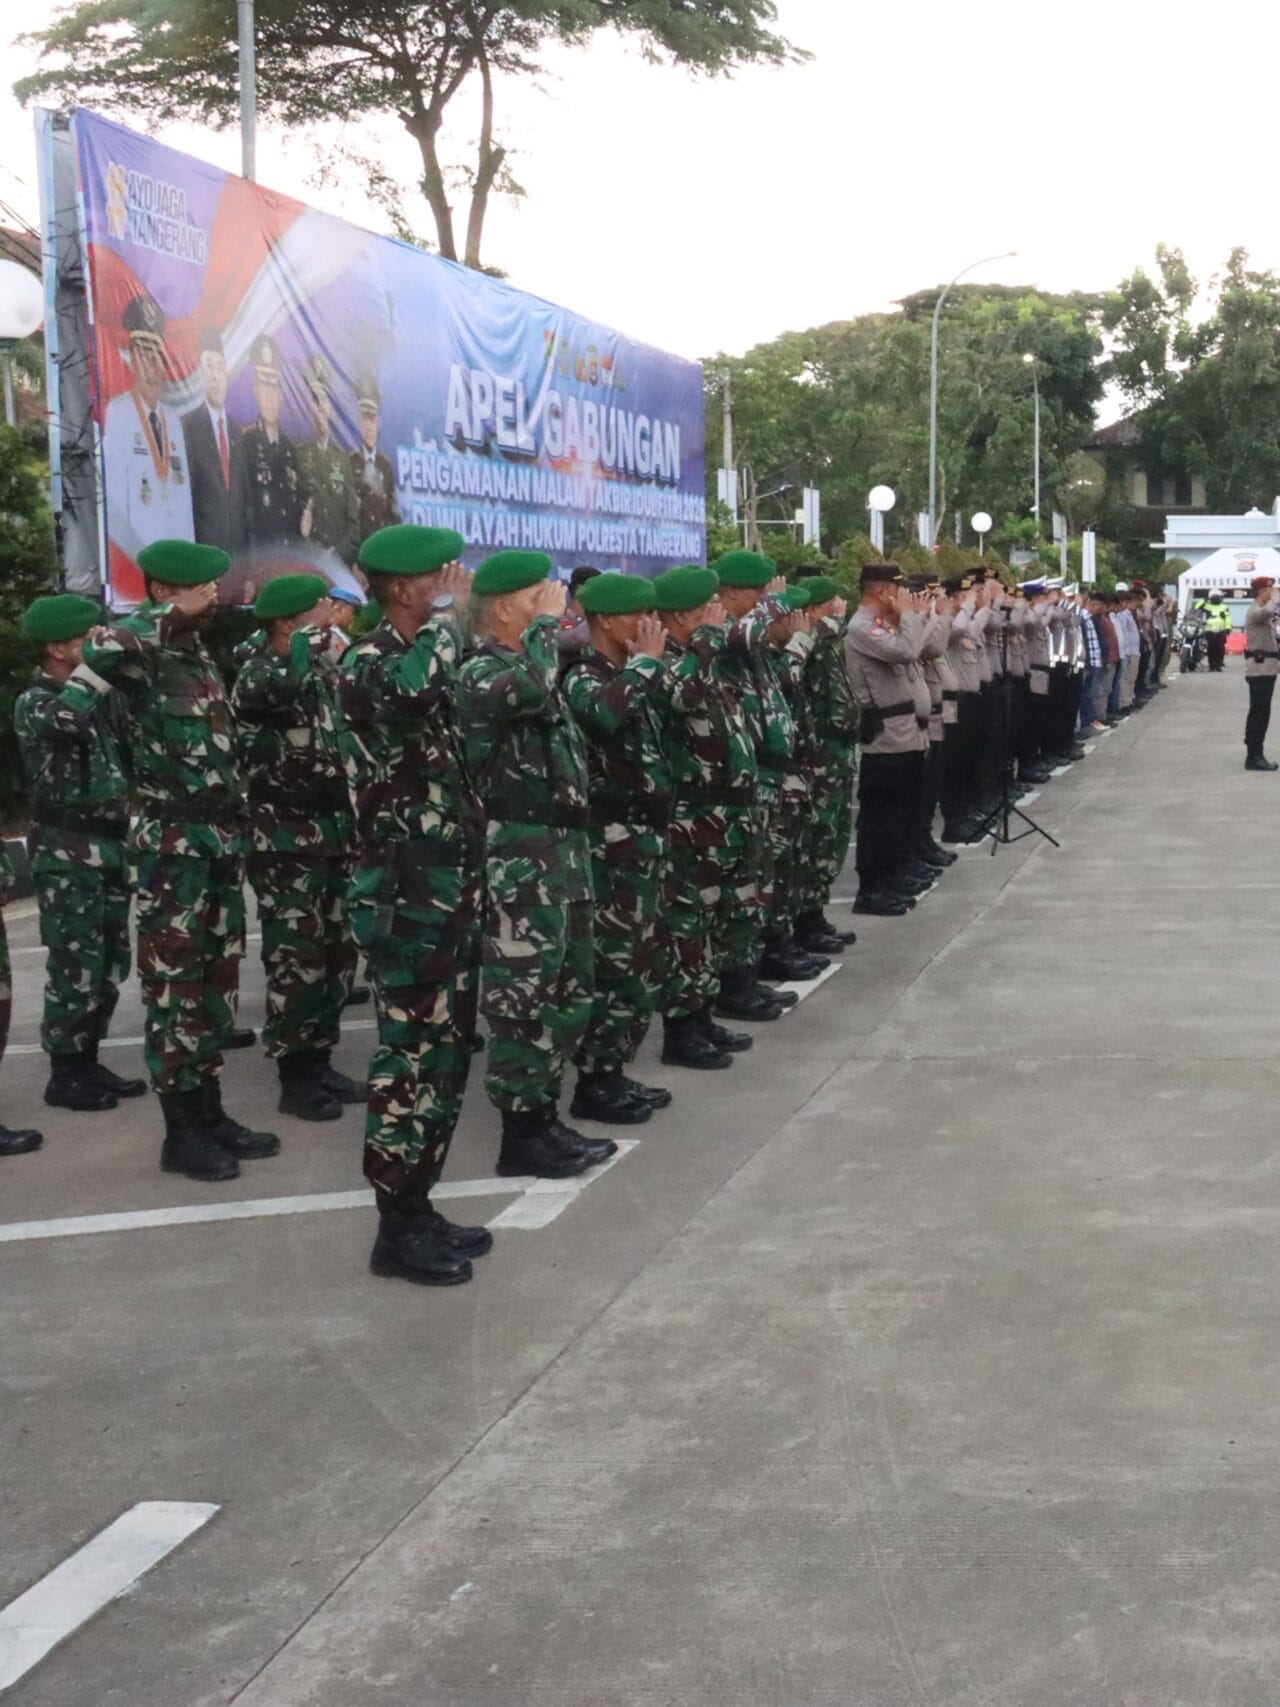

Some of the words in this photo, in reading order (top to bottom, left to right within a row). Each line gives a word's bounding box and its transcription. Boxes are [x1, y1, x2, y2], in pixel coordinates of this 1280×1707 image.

[444, 363, 536, 453] APEL
[542, 389, 681, 482] GABUNGAN
[397, 447, 531, 501] PENGAMANAN
[532, 465, 586, 509] MALAM
[522, 512, 576, 551] HUKUM
[578, 520, 638, 554] POLRESTA
[638, 526, 701, 559] TANGERANG
